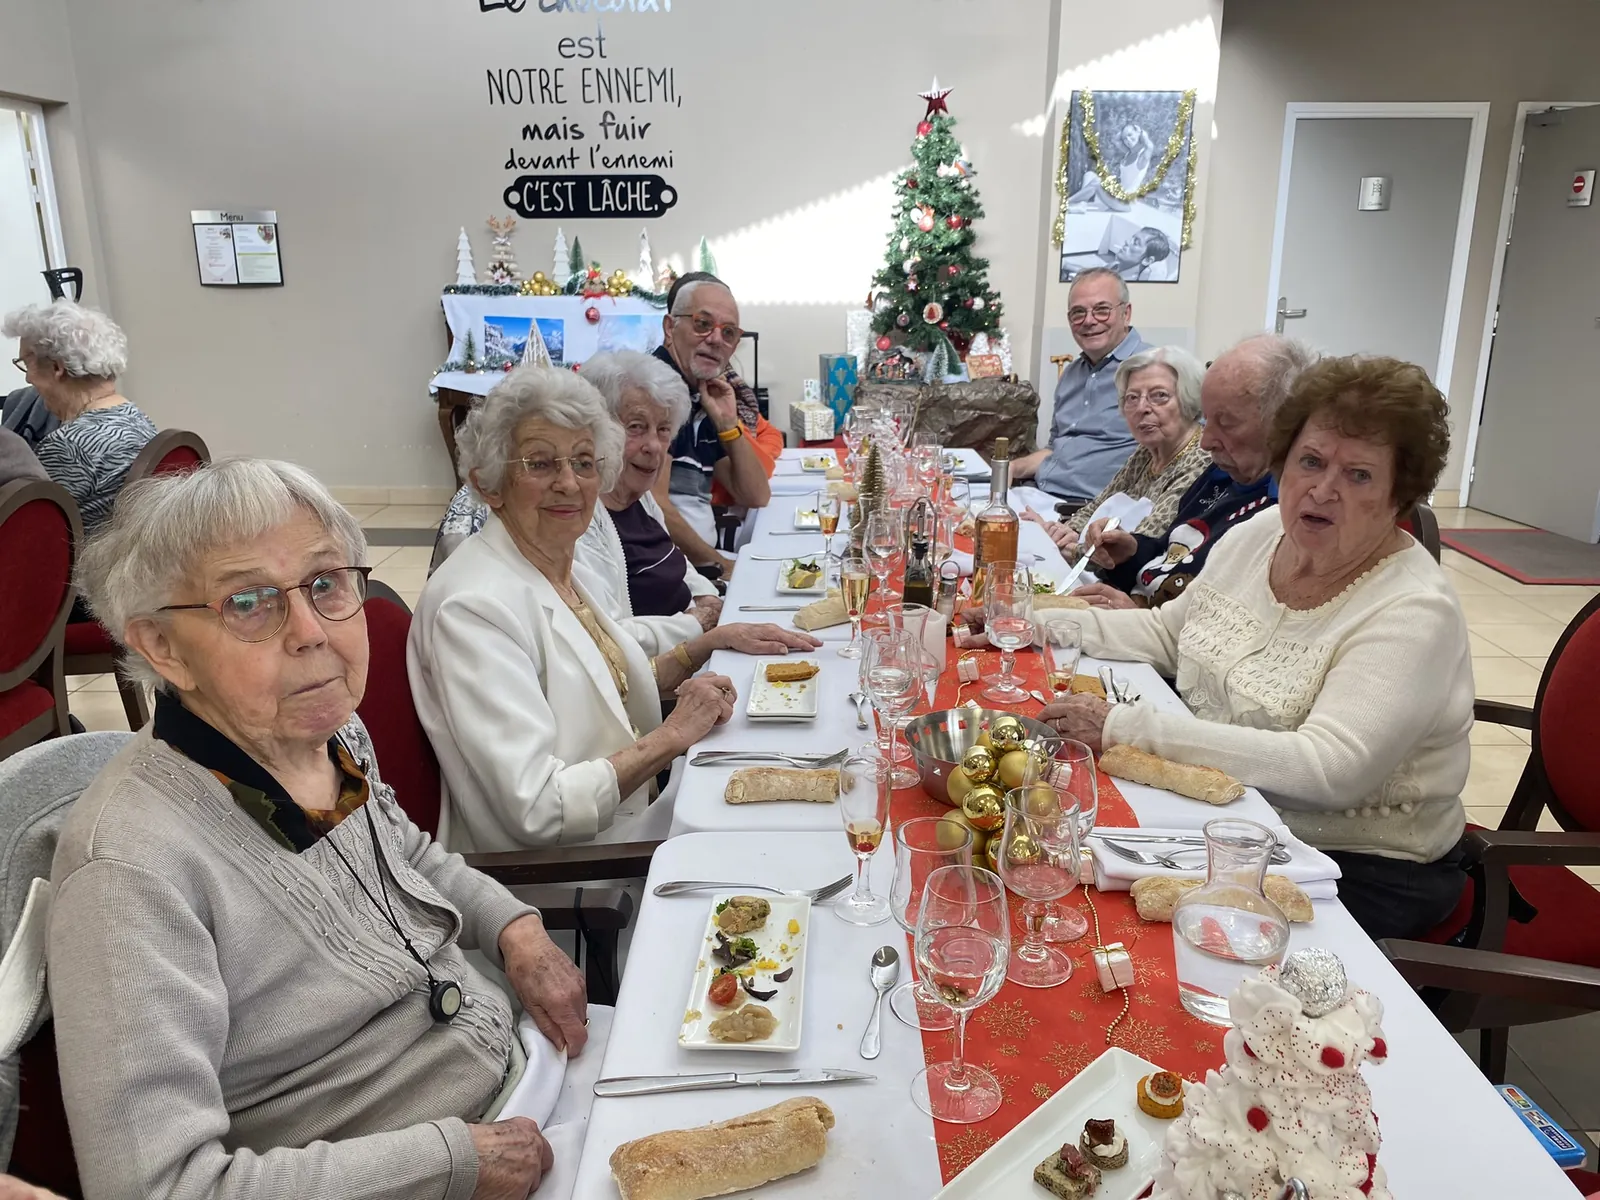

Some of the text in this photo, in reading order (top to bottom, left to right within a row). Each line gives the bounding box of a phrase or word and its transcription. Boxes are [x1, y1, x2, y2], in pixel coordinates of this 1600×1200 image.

[558, 20, 607, 59] est
[487, 67, 682, 108] NOTRE ENNEMI,
[522, 111, 652, 141] mais fuir
[504, 144, 674, 170] devant l'ennemi
[523, 179, 659, 212] C'EST LÂCHE.
[220, 213, 244, 221] Menu
